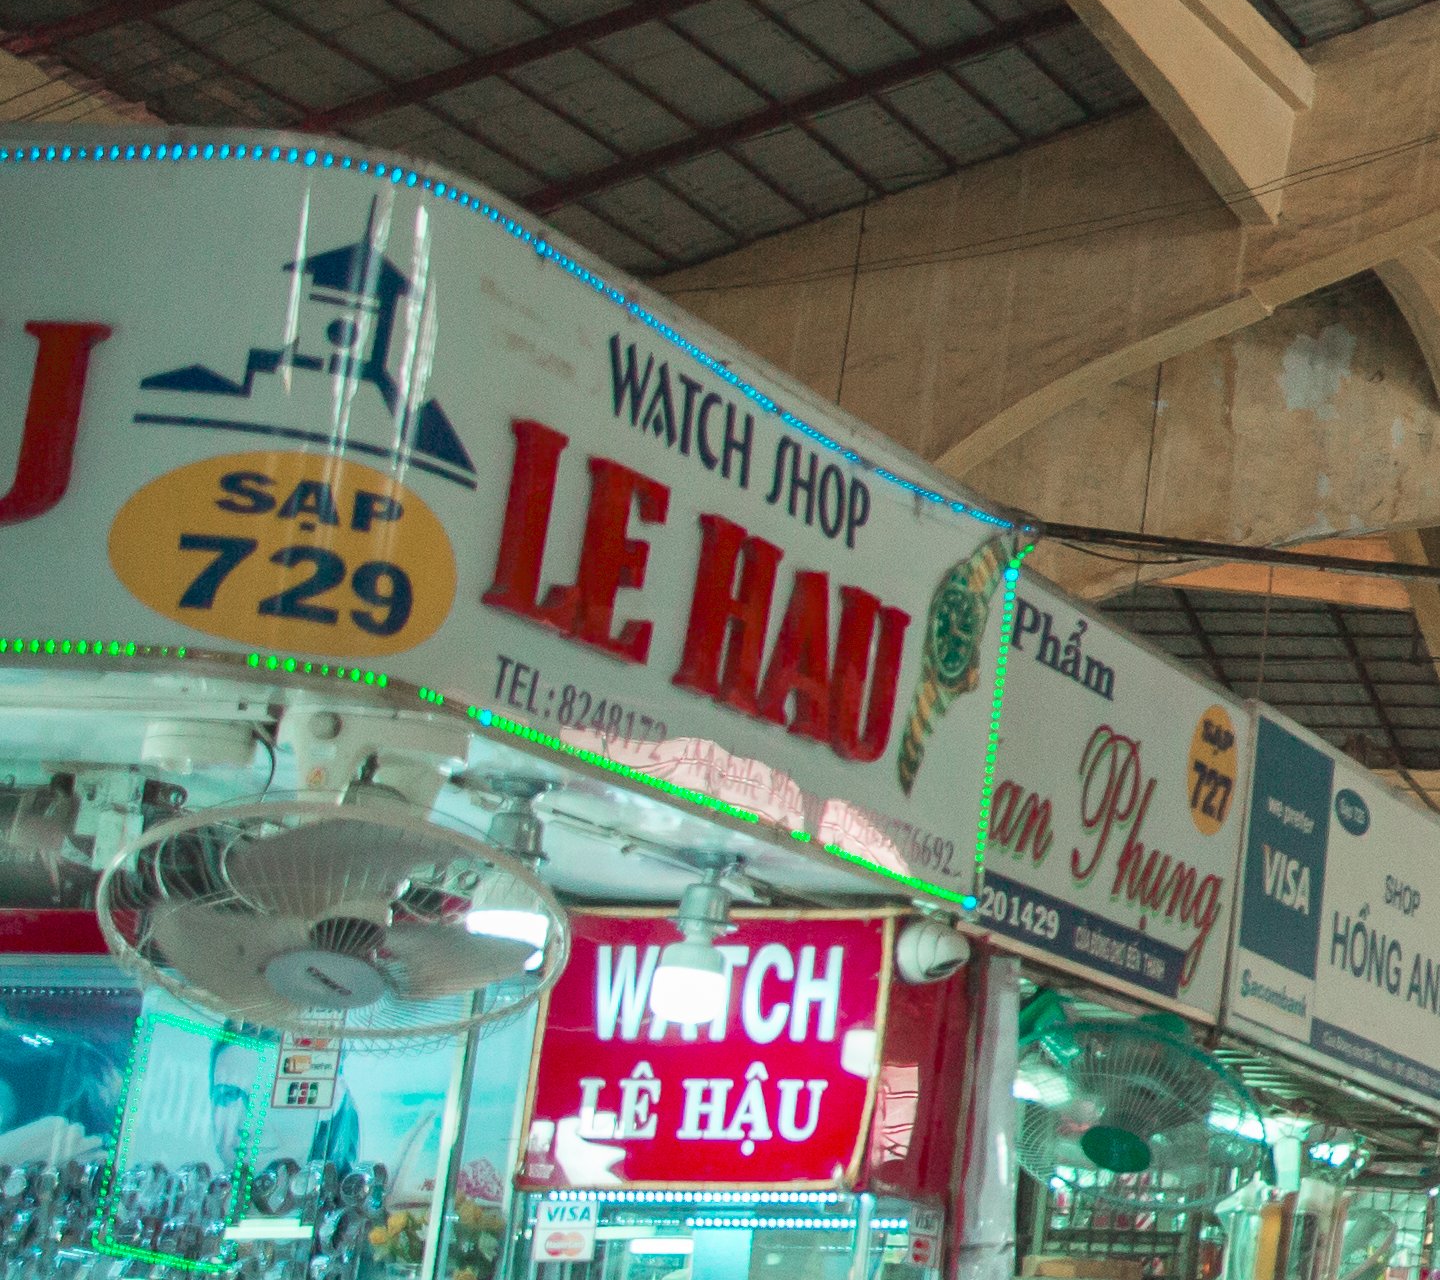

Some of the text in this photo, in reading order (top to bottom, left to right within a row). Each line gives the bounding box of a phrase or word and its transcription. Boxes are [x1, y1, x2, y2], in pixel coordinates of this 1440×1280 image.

[608, 333, 872, 549] WATCH SHOP
[215, 470, 405, 533] SẠP
[178, 533, 414, 637] 729
[481, 419, 912, 764] LE HAU
[1011, 596, 1116, 702] Phẩm
[1190, 759, 1234, 822] 727
[1071, 723, 1225, 989] Phụng
[1262, 843, 1312, 916] VISA
[1384, 872, 1422, 917] SHOP
[1240, 967, 1307, 1019] Sacombank
[578, 1060, 831, 1158] LÊ HẬU
[546, 1206, 591, 1224] VISA
